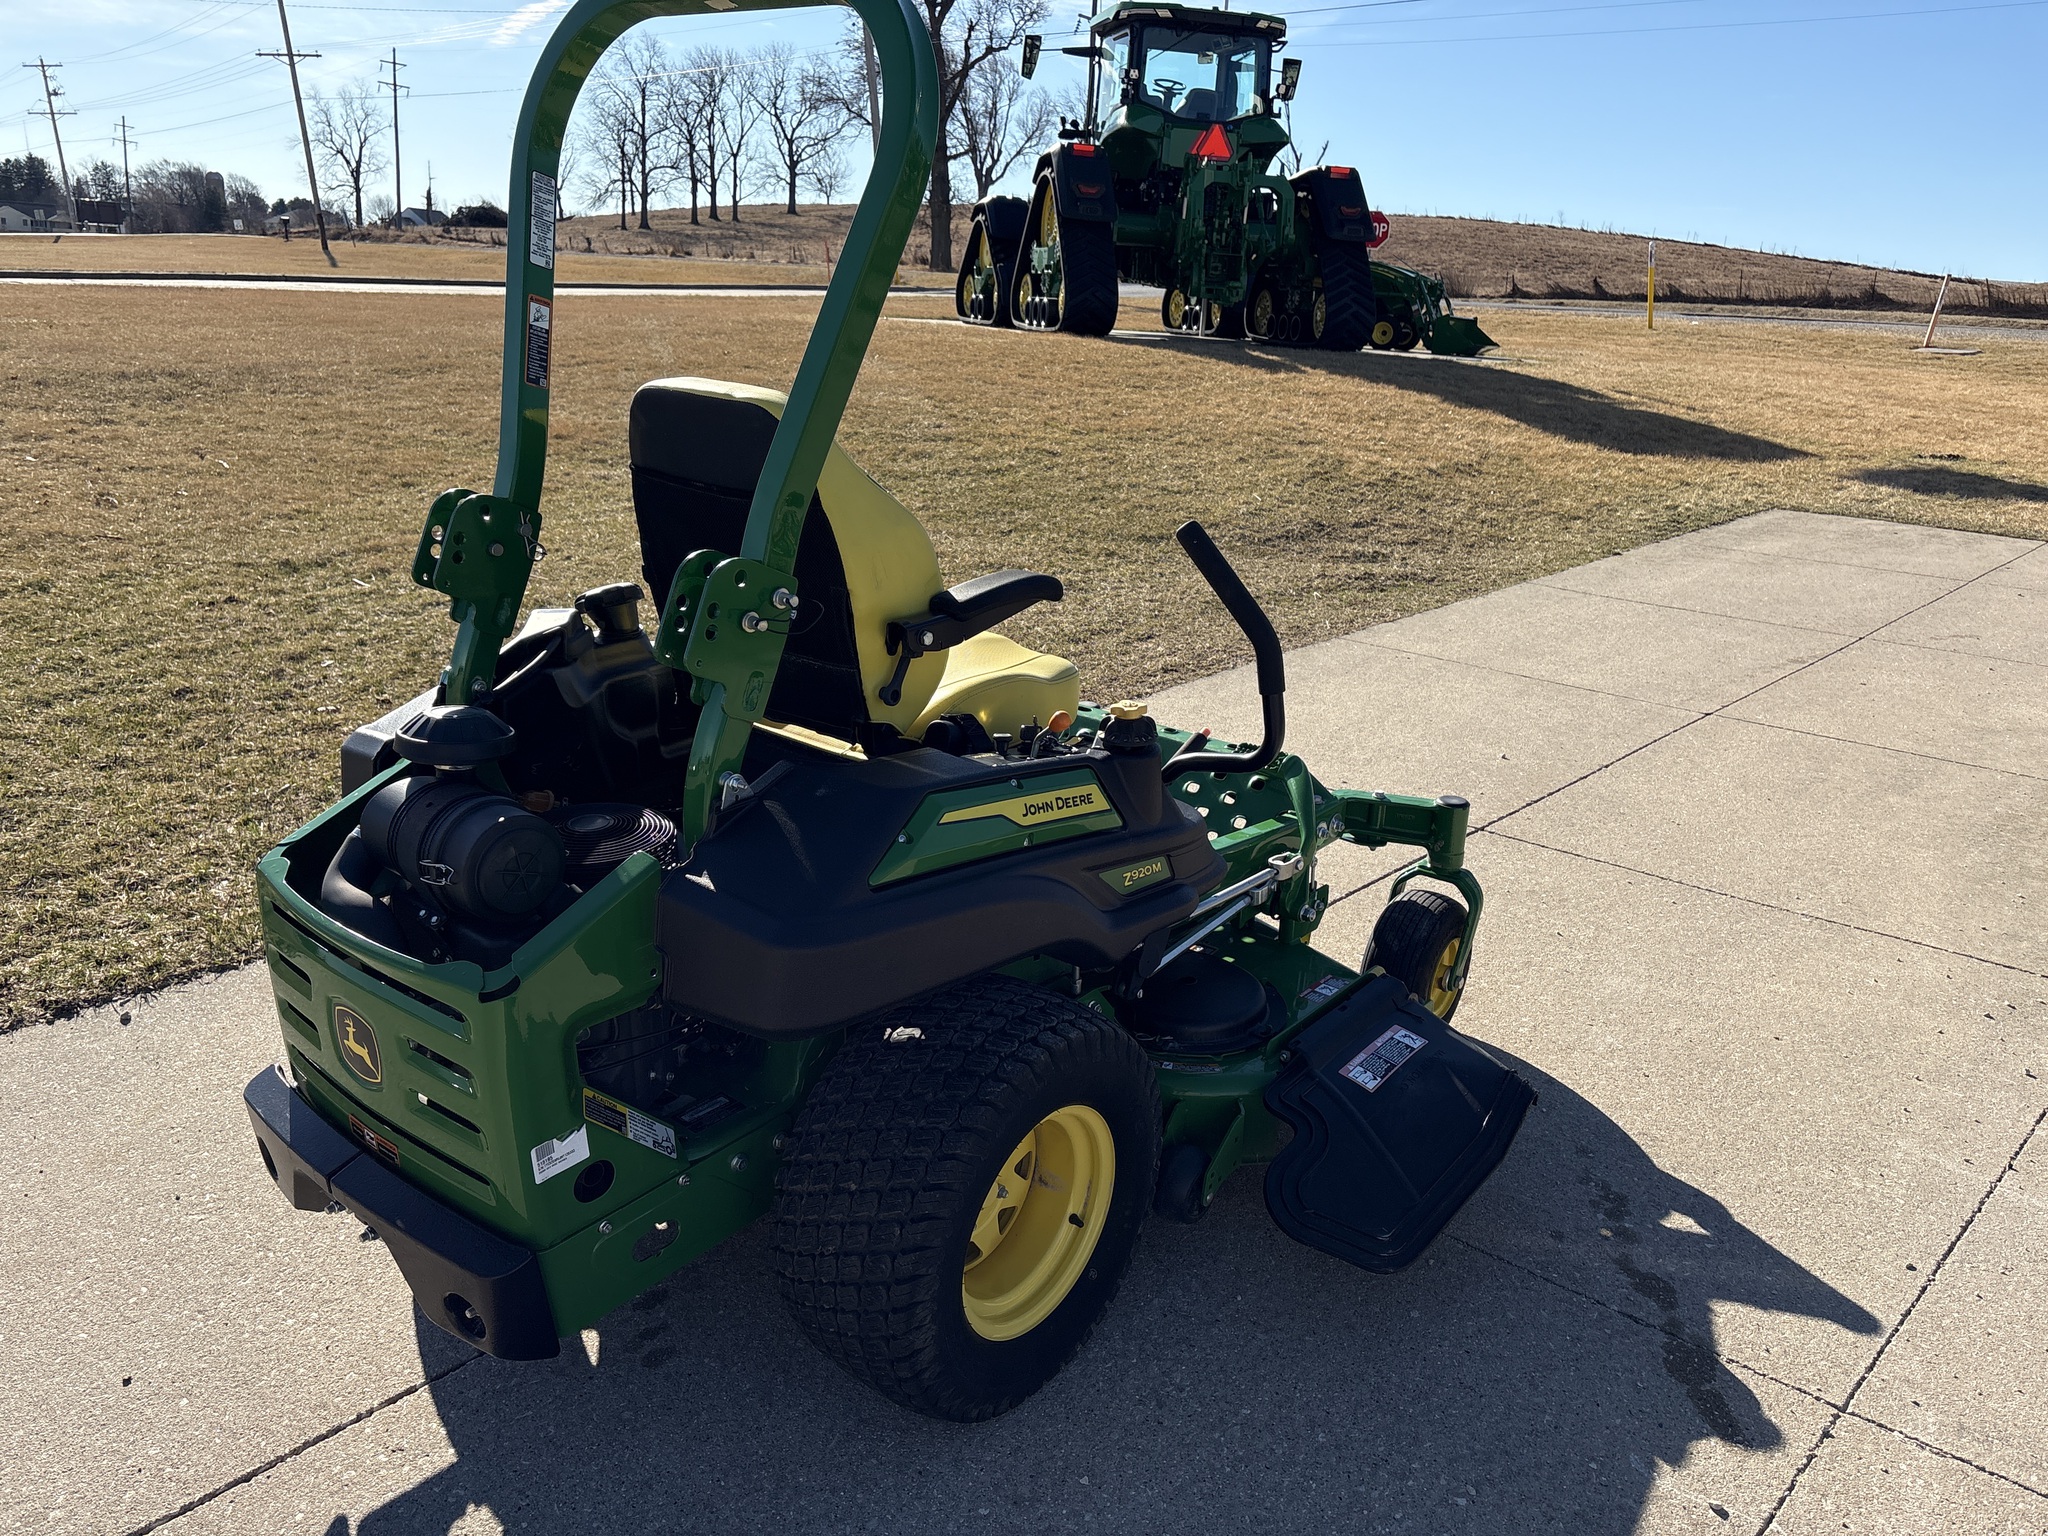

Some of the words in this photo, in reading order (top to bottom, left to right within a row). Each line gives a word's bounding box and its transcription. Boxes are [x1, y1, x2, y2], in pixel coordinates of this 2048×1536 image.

[1373, 223, 1387, 237] OP
[1022, 800, 1054, 817] JOHN
[1055, 793, 1094, 810] DEERE
